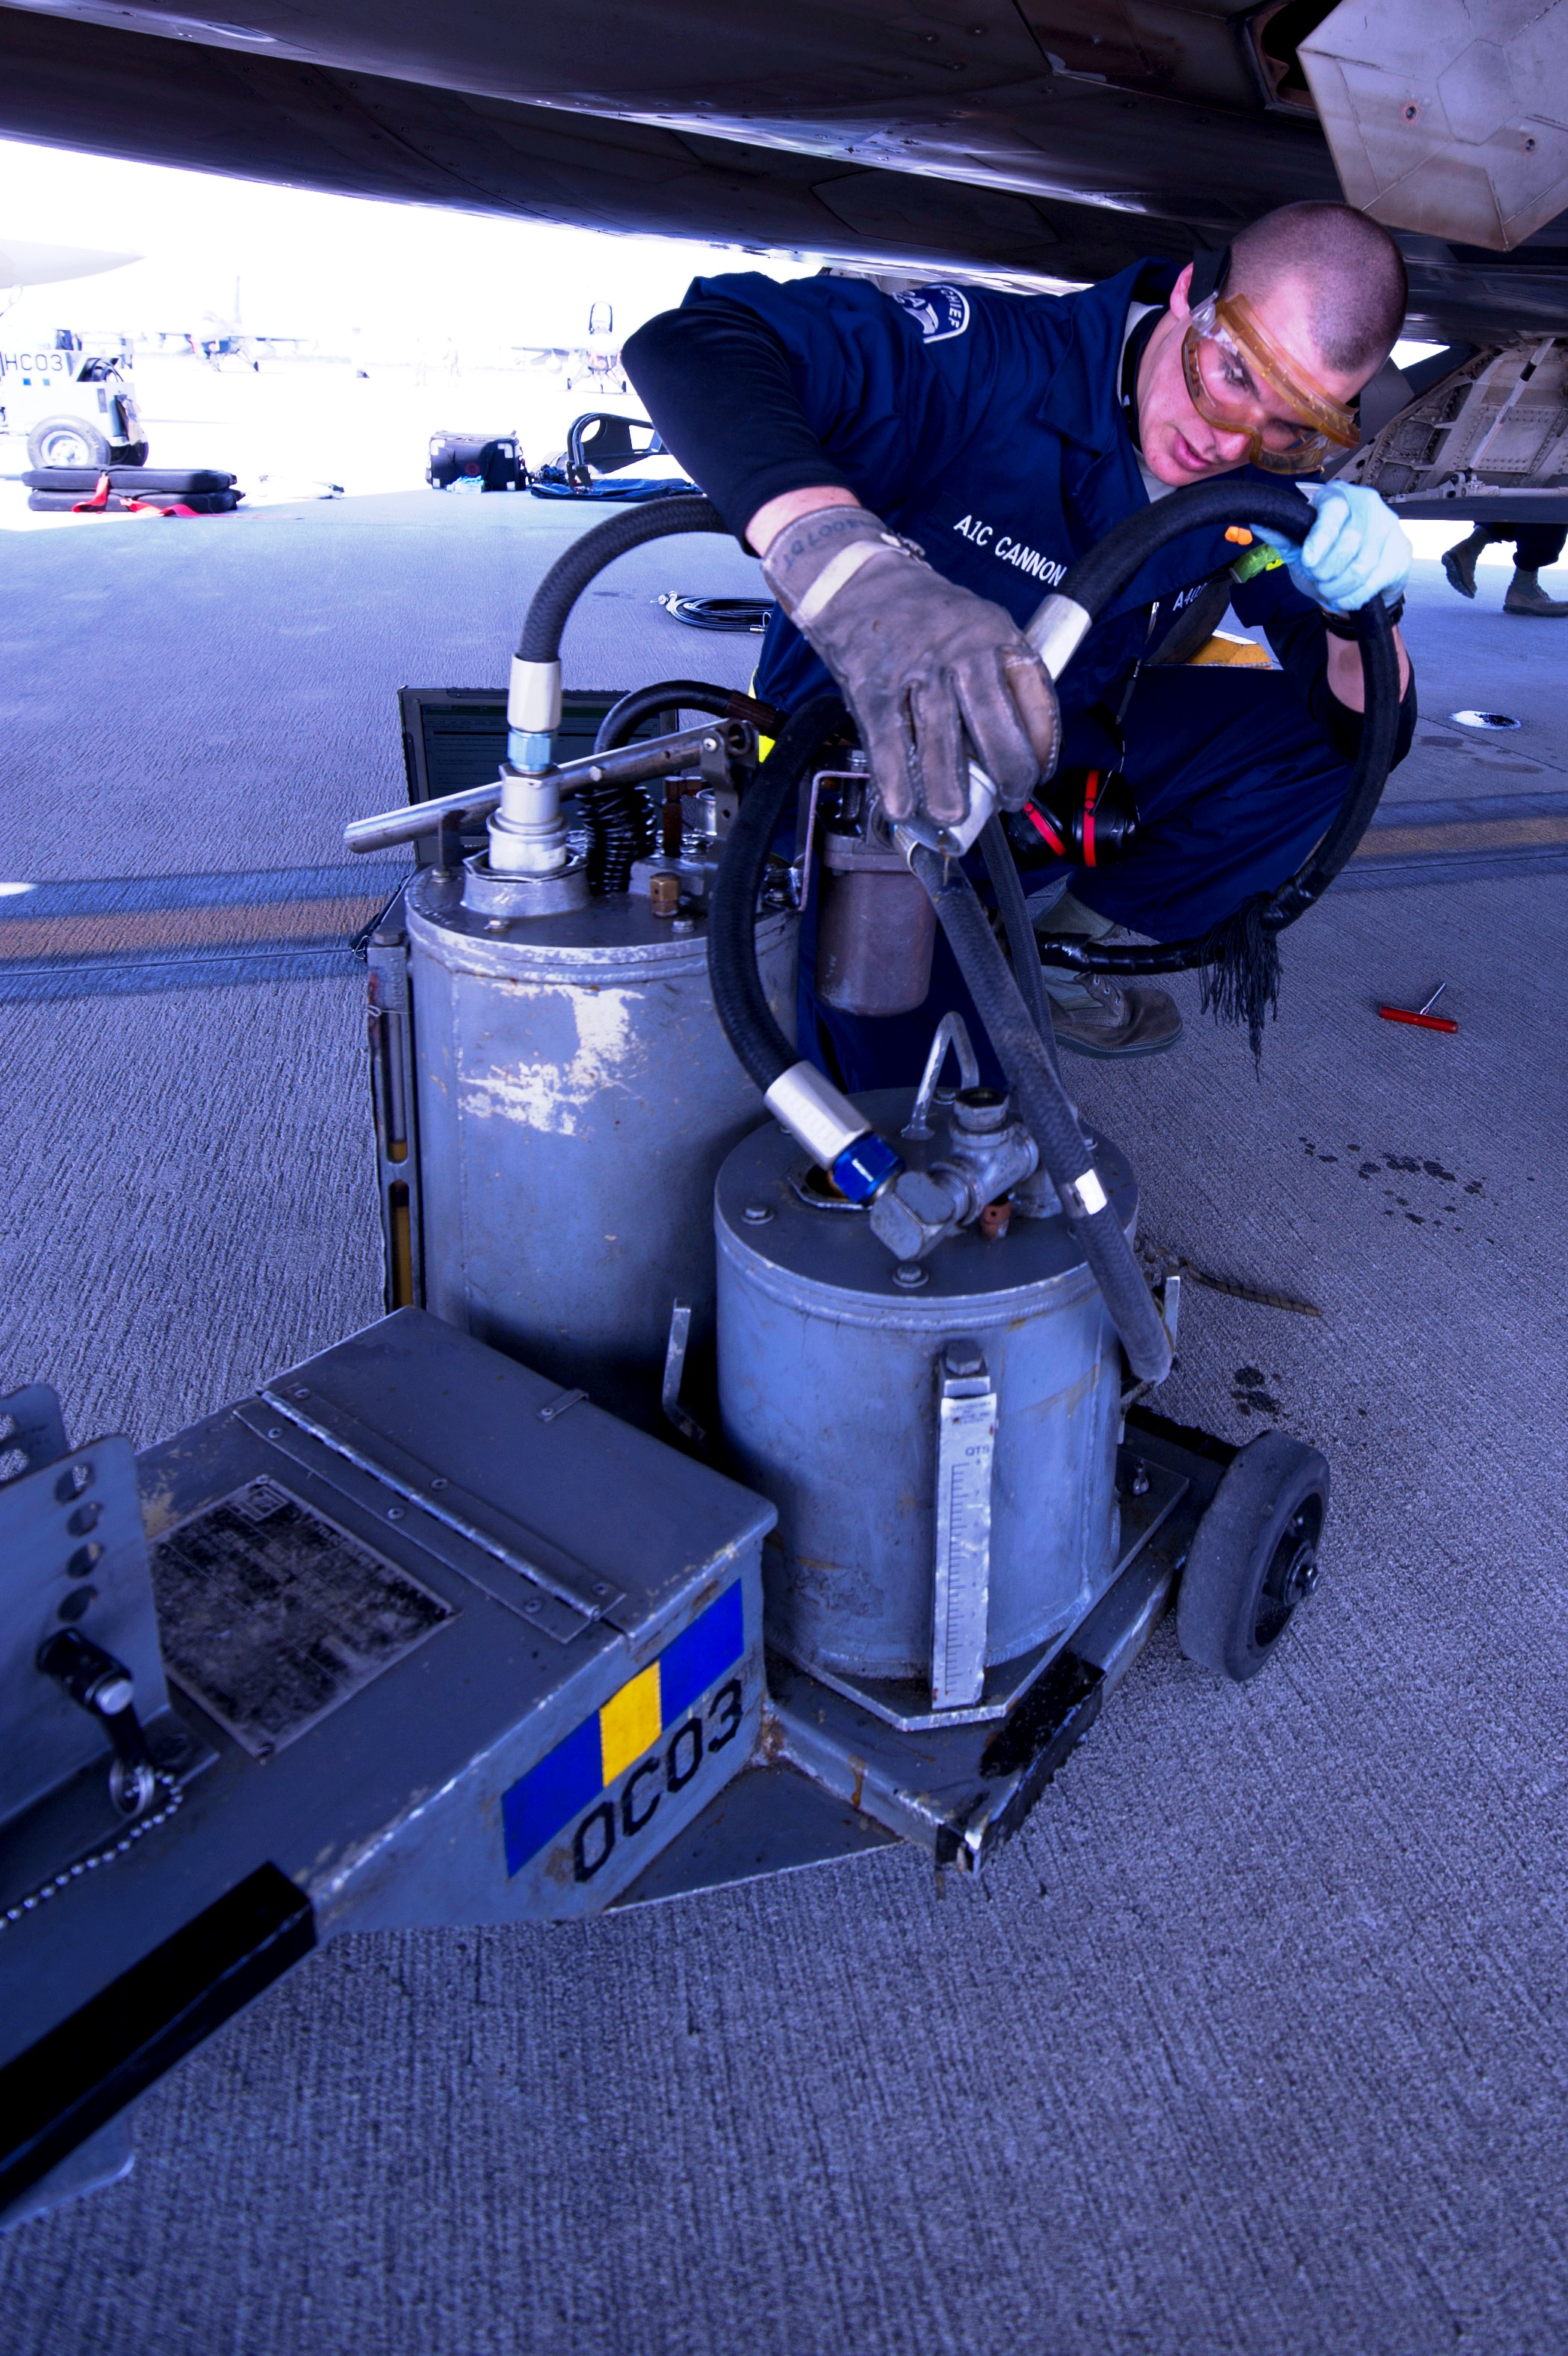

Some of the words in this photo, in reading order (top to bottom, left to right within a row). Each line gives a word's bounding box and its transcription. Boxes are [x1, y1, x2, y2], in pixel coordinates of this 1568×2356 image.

[941, 289, 962, 329] CHIEF
[953, 514, 994, 546] A1C
[994, 536, 1067, 587] CANNON
